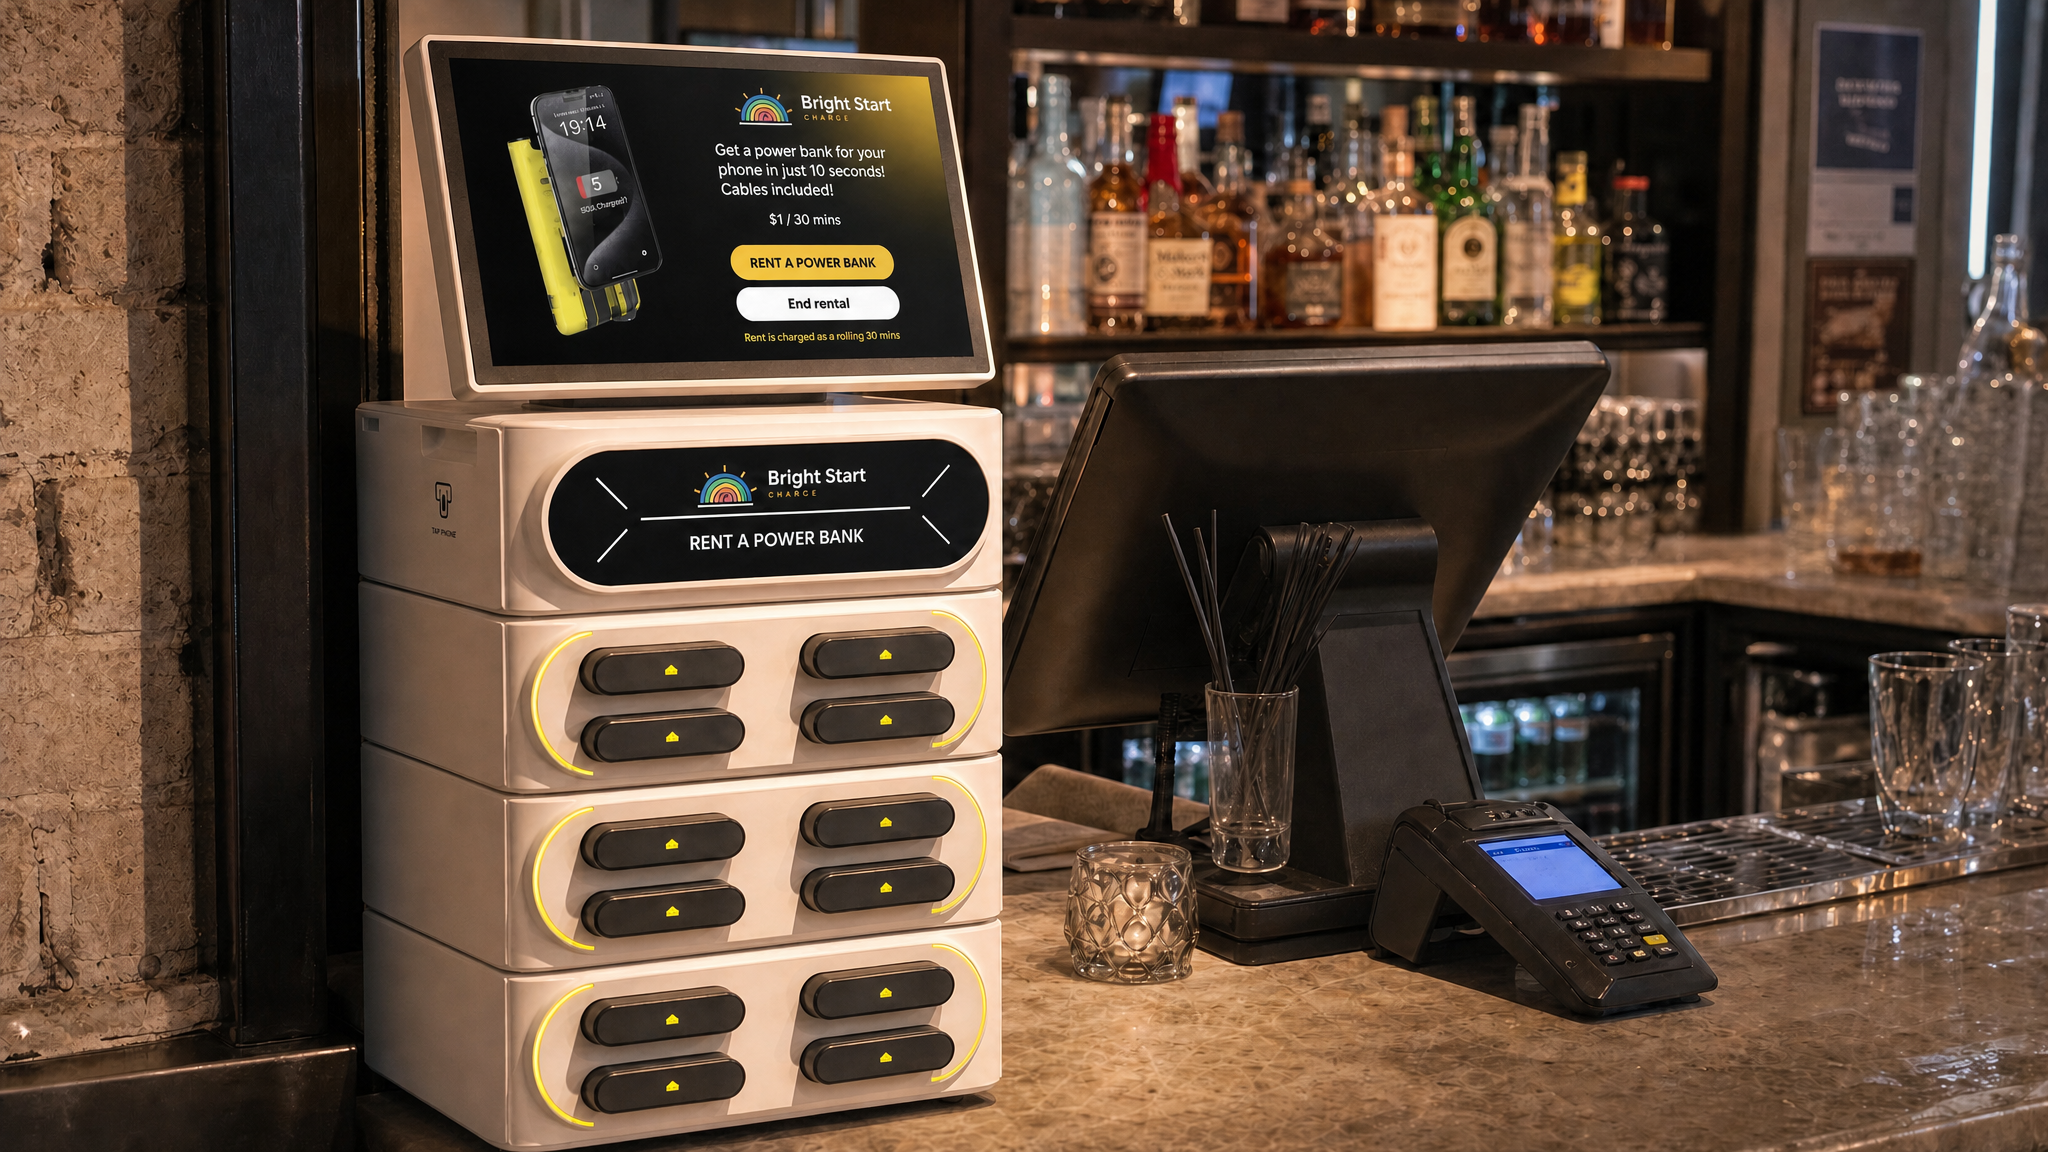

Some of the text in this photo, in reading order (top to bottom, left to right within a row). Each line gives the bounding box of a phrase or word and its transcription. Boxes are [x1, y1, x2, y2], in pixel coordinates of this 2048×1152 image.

[800, 94, 892, 114] Bright Start
[559, 114, 607, 137] 19:14
[803, 114, 849, 122] CHARGE
[715, 143, 886, 161] Get a power bank for your
[718, 162, 886, 179] phone in just 10 seconds!
[591, 176, 602, 191] 5
[721, 182, 834, 197] Cables included!
[769, 212, 842, 226] $1 / 30 mins
[750, 257, 877, 269] RENT A POWER BANK
[787, 297, 850, 309] End rental
[744, 332, 767, 343] Rent
[768, 332, 776, 342] is
[777, 332, 815, 344] charged
[836, 331, 865, 343] rolling
[866, 331, 878, 341] 30
[879, 331, 901, 341] mins
[768, 468, 867, 489] Bright Start
[768, 489, 817, 498] CHARGE
[689, 528, 864, 551] RENT A POWER BANK
